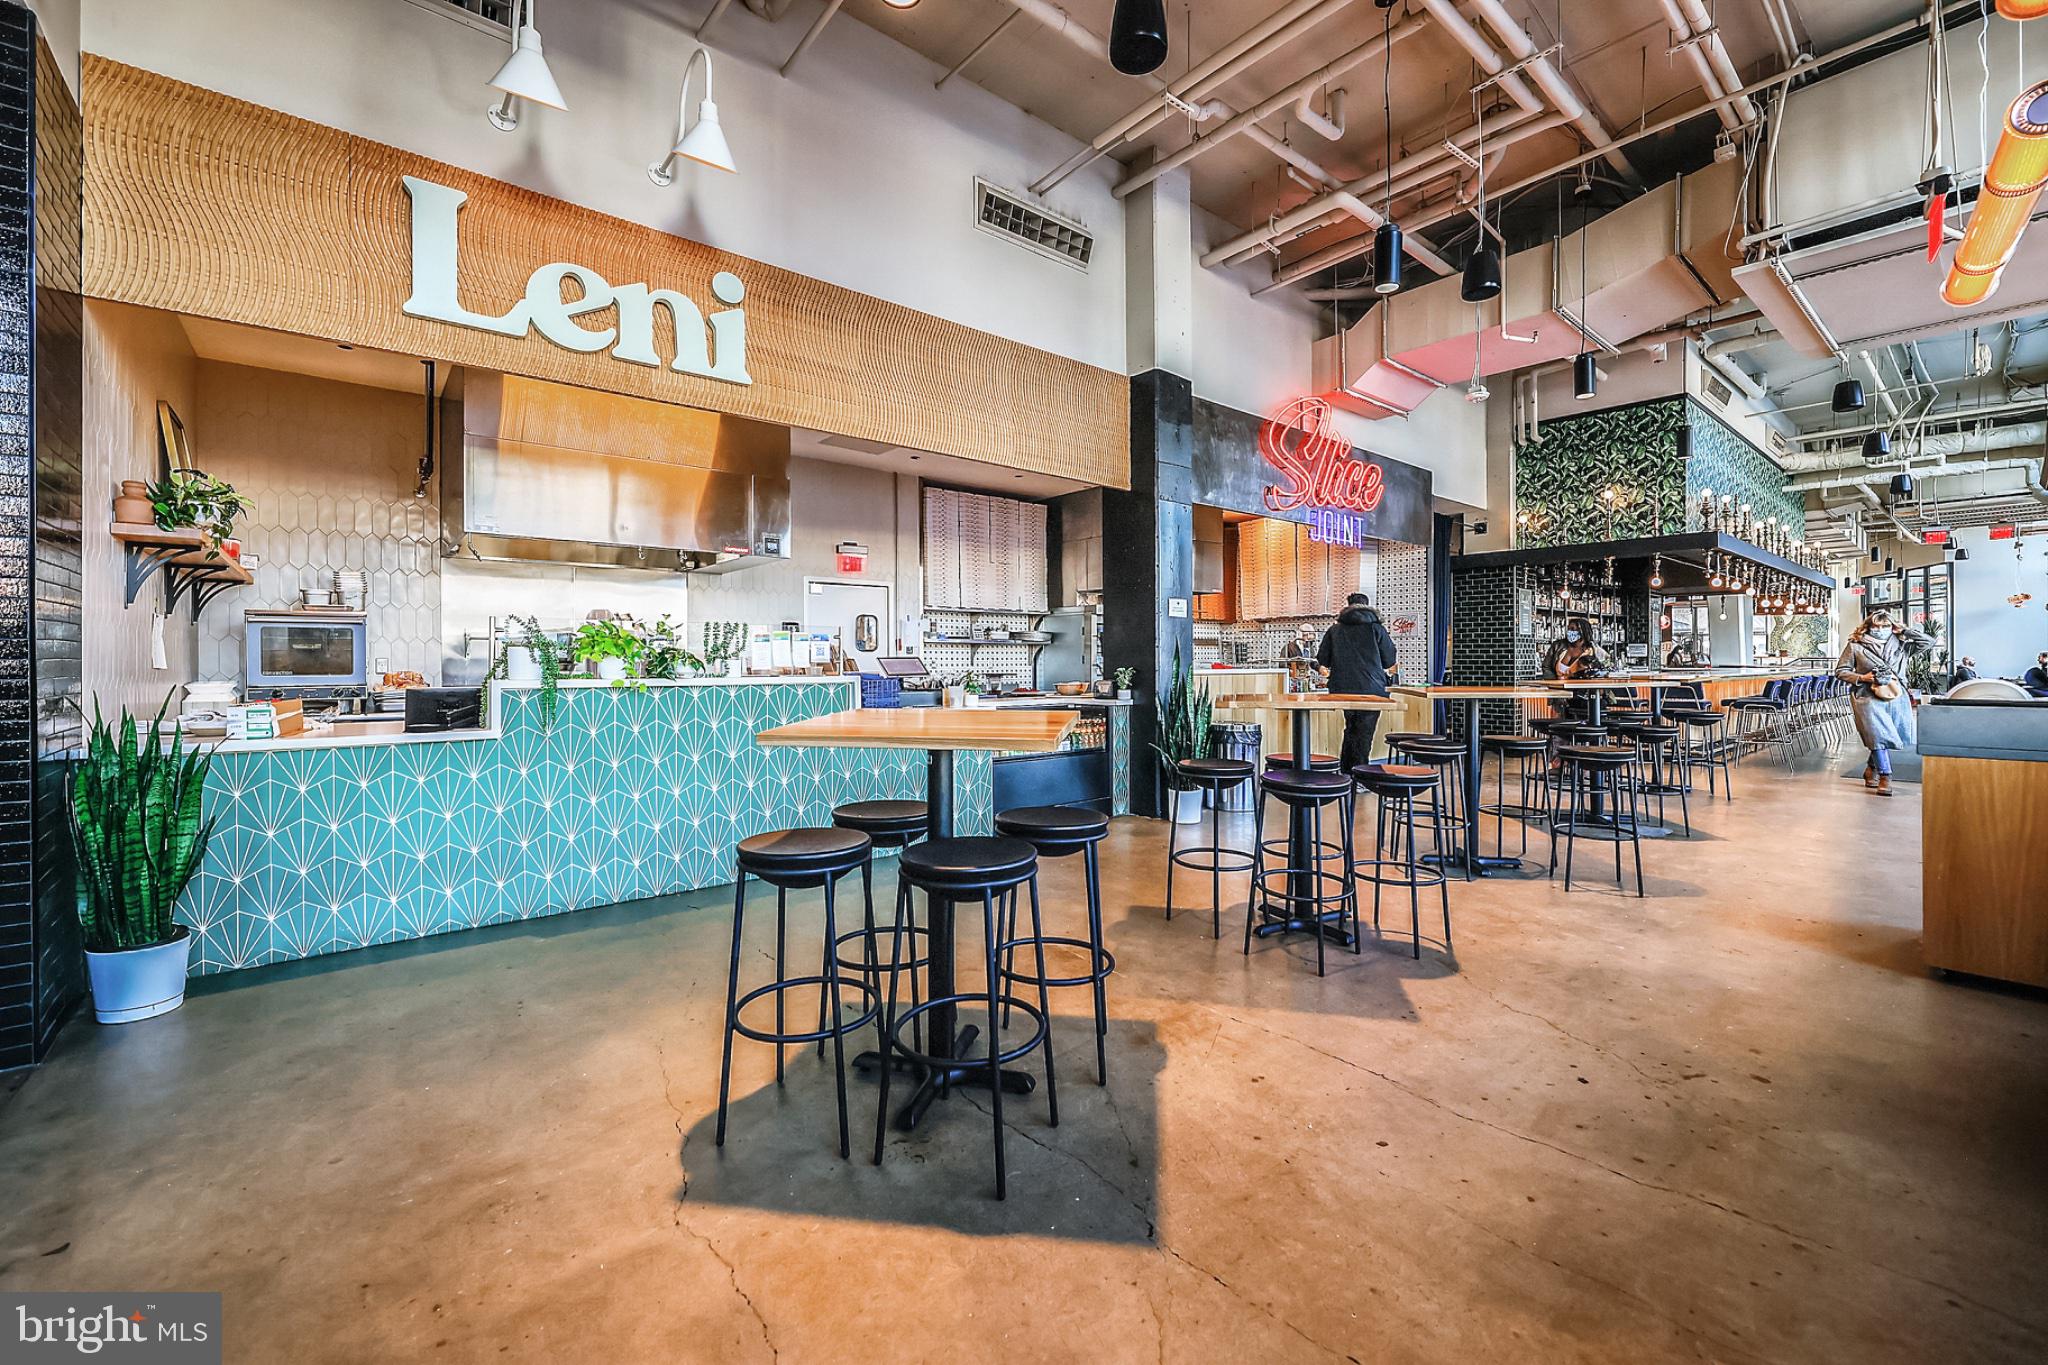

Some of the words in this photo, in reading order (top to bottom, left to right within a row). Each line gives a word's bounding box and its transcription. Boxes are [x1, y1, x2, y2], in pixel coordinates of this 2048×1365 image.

[402, 175, 753, 386] Leni
[1264, 396, 1385, 511] Slice
[1309, 510, 1365, 548] JOINT
